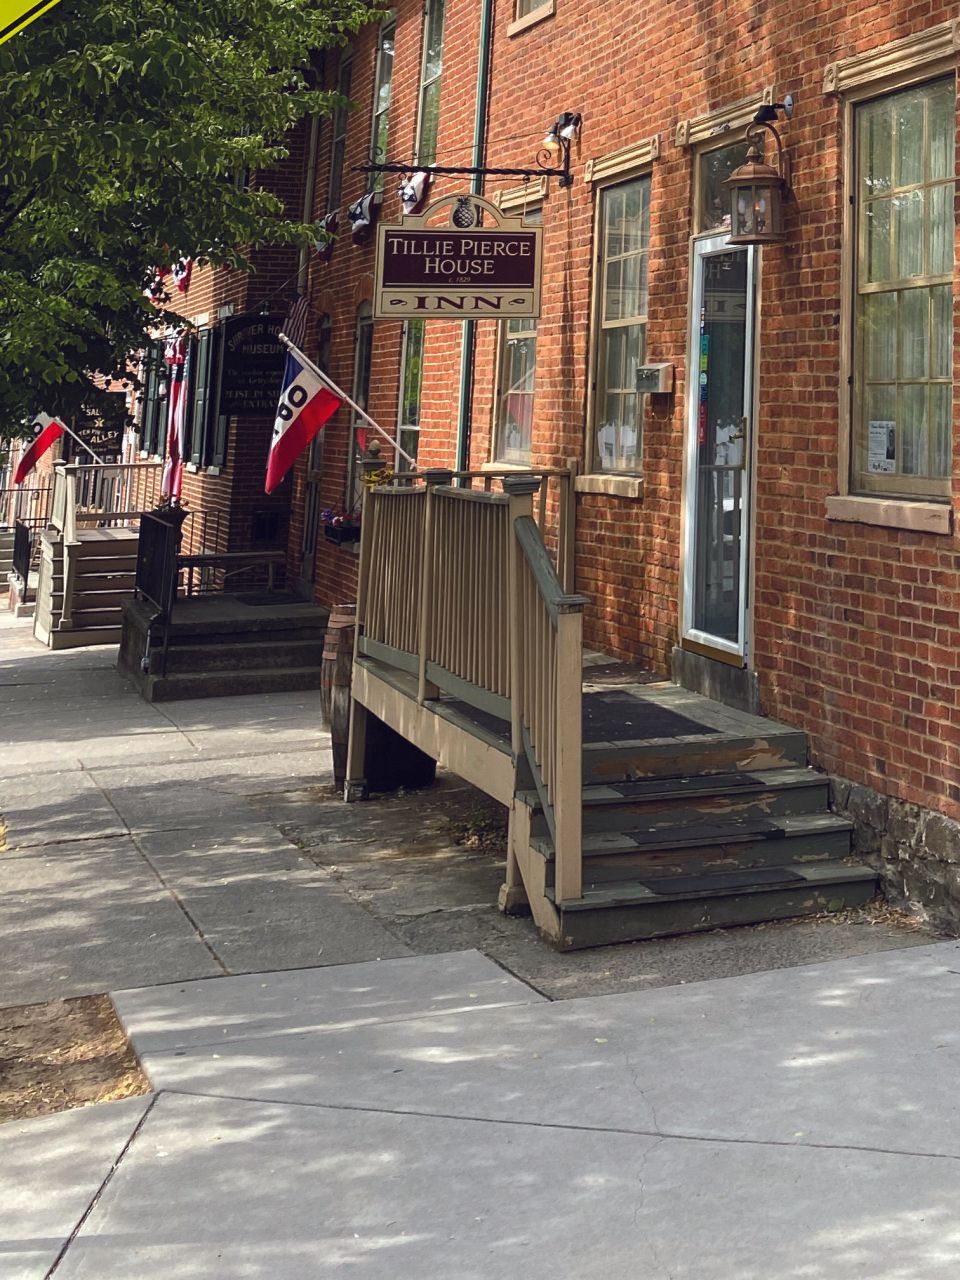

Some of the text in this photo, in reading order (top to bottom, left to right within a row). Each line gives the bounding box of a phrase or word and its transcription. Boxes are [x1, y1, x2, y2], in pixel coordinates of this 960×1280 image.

[388, 238, 531, 256] TILLIE PIERCE
[423, 257, 495, 275] HOUSE
[413, 295, 504, 310] INN
[242, 343, 284, 354] MUSEUM
[89, 430, 119, 444] ALLEY
